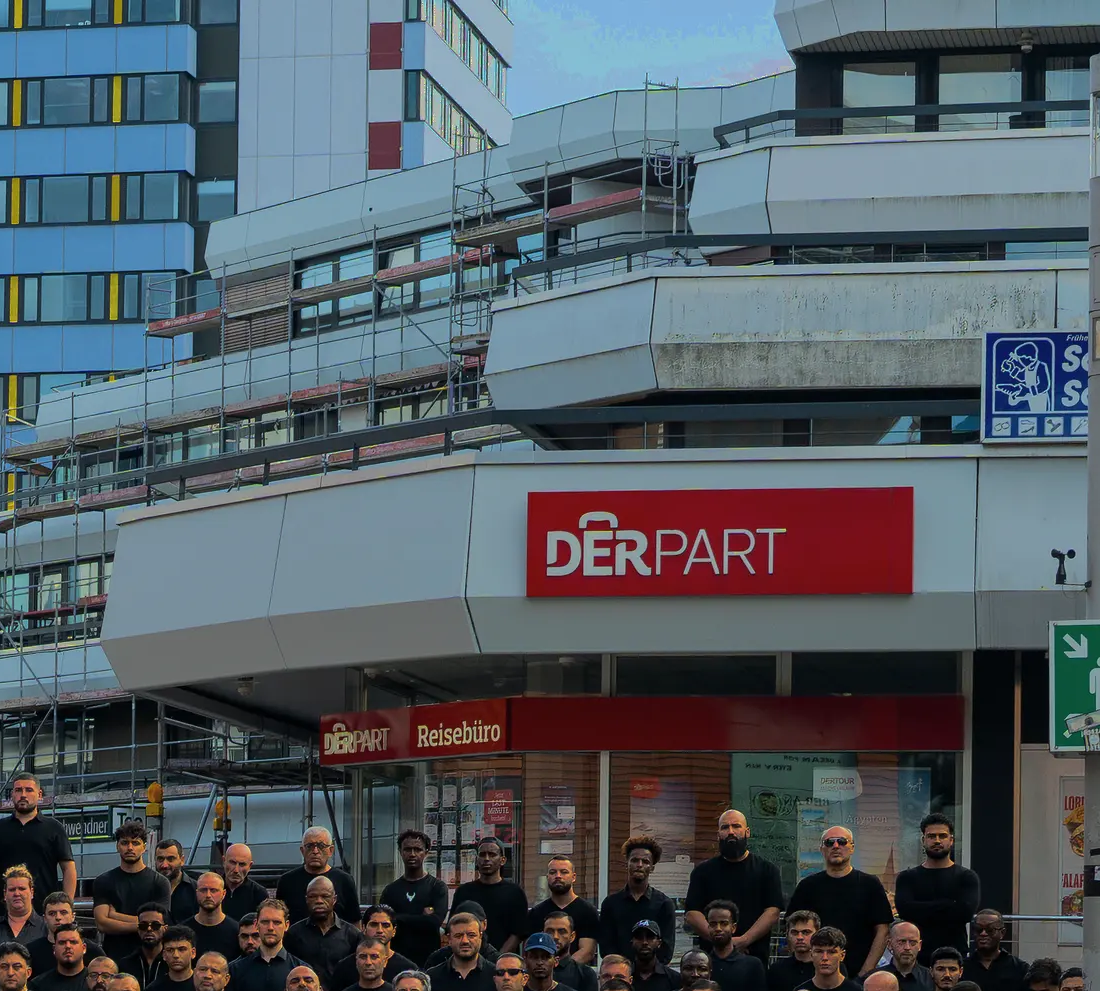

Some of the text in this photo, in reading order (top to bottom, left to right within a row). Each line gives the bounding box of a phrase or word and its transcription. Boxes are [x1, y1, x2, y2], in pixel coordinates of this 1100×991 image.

[546, 524, 786, 577] DERPART
[323, 724, 391, 756] DERPART
[416, 720, 501, 749] Reisebüro
[1064, 795, 1085, 811] LOR
[1062, 873, 1085, 889] ALAF
